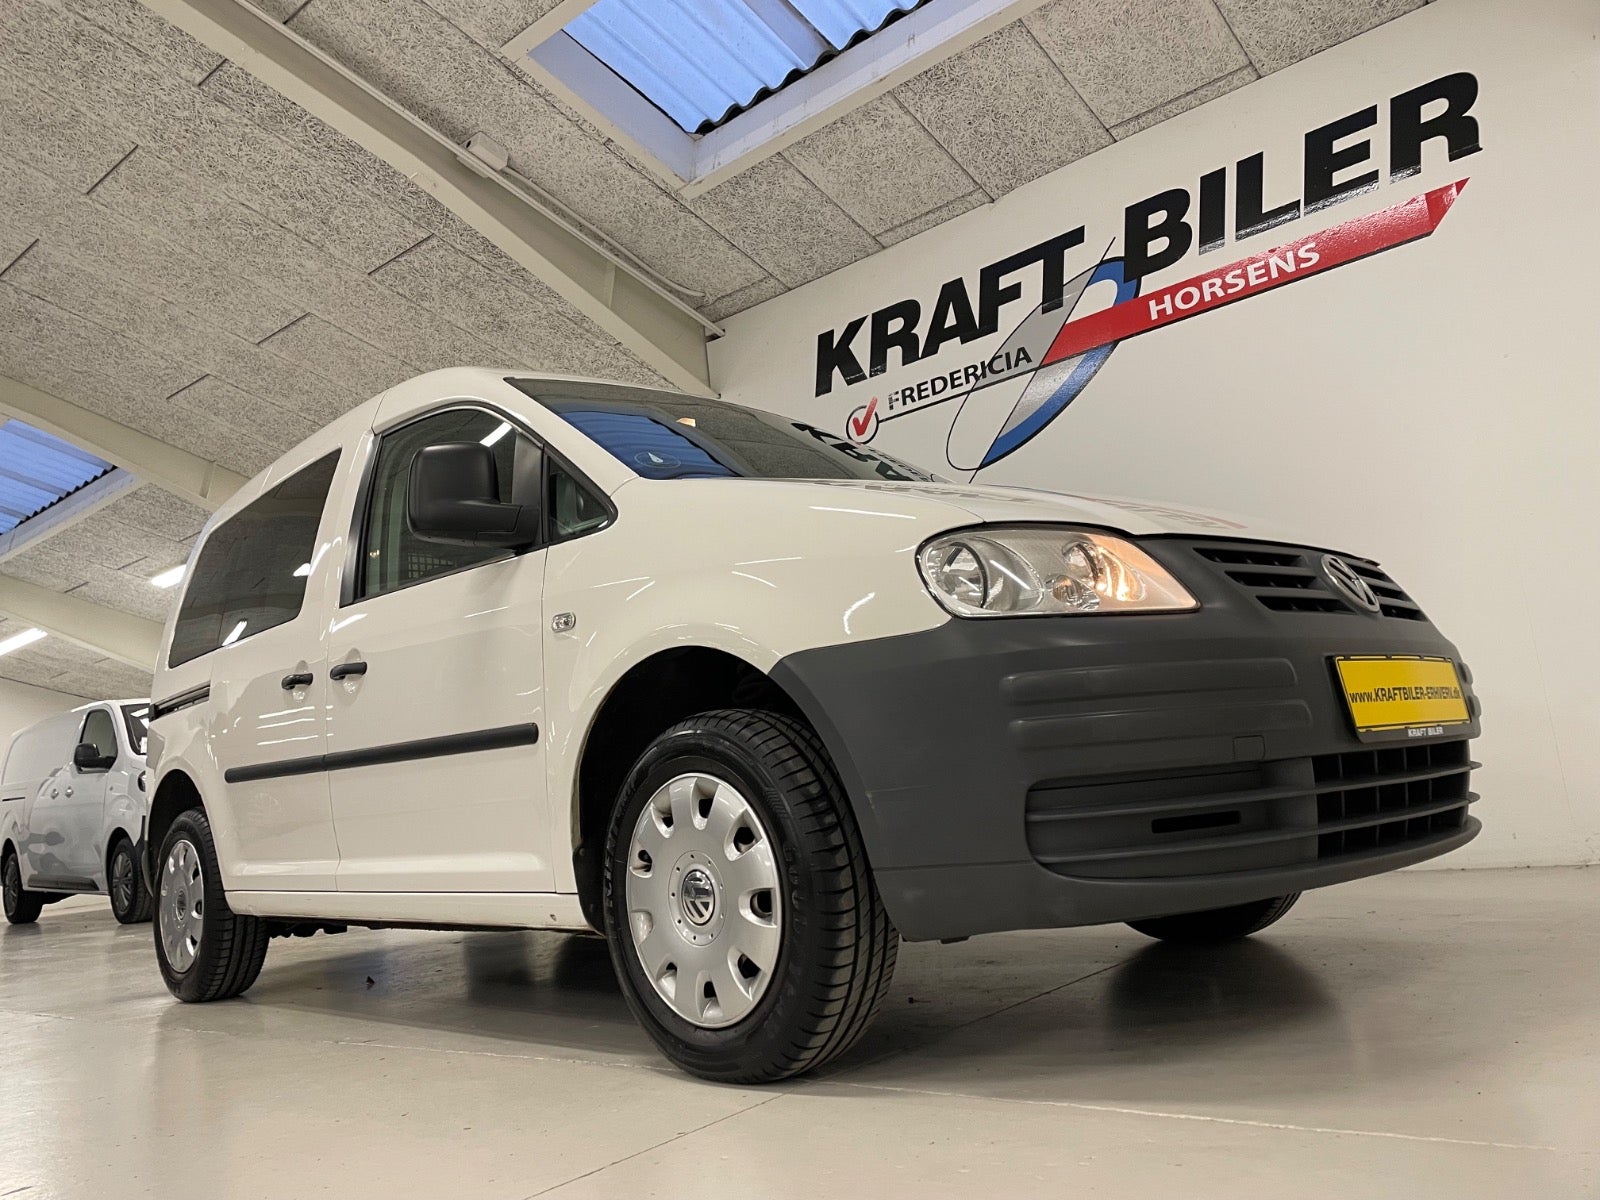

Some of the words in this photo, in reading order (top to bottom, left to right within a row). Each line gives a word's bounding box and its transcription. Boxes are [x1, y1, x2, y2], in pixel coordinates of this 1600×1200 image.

[814, 225, 1085, 397] KRAFT
[1123, 71, 1483, 283] BILER
[1148, 242, 1322, 321] HORSENS
[887, 346, 1033, 410] FREDERICIA
[1408, 728, 1426, 737] KRAFT
[1427, 726, 1443, 736] BILER
